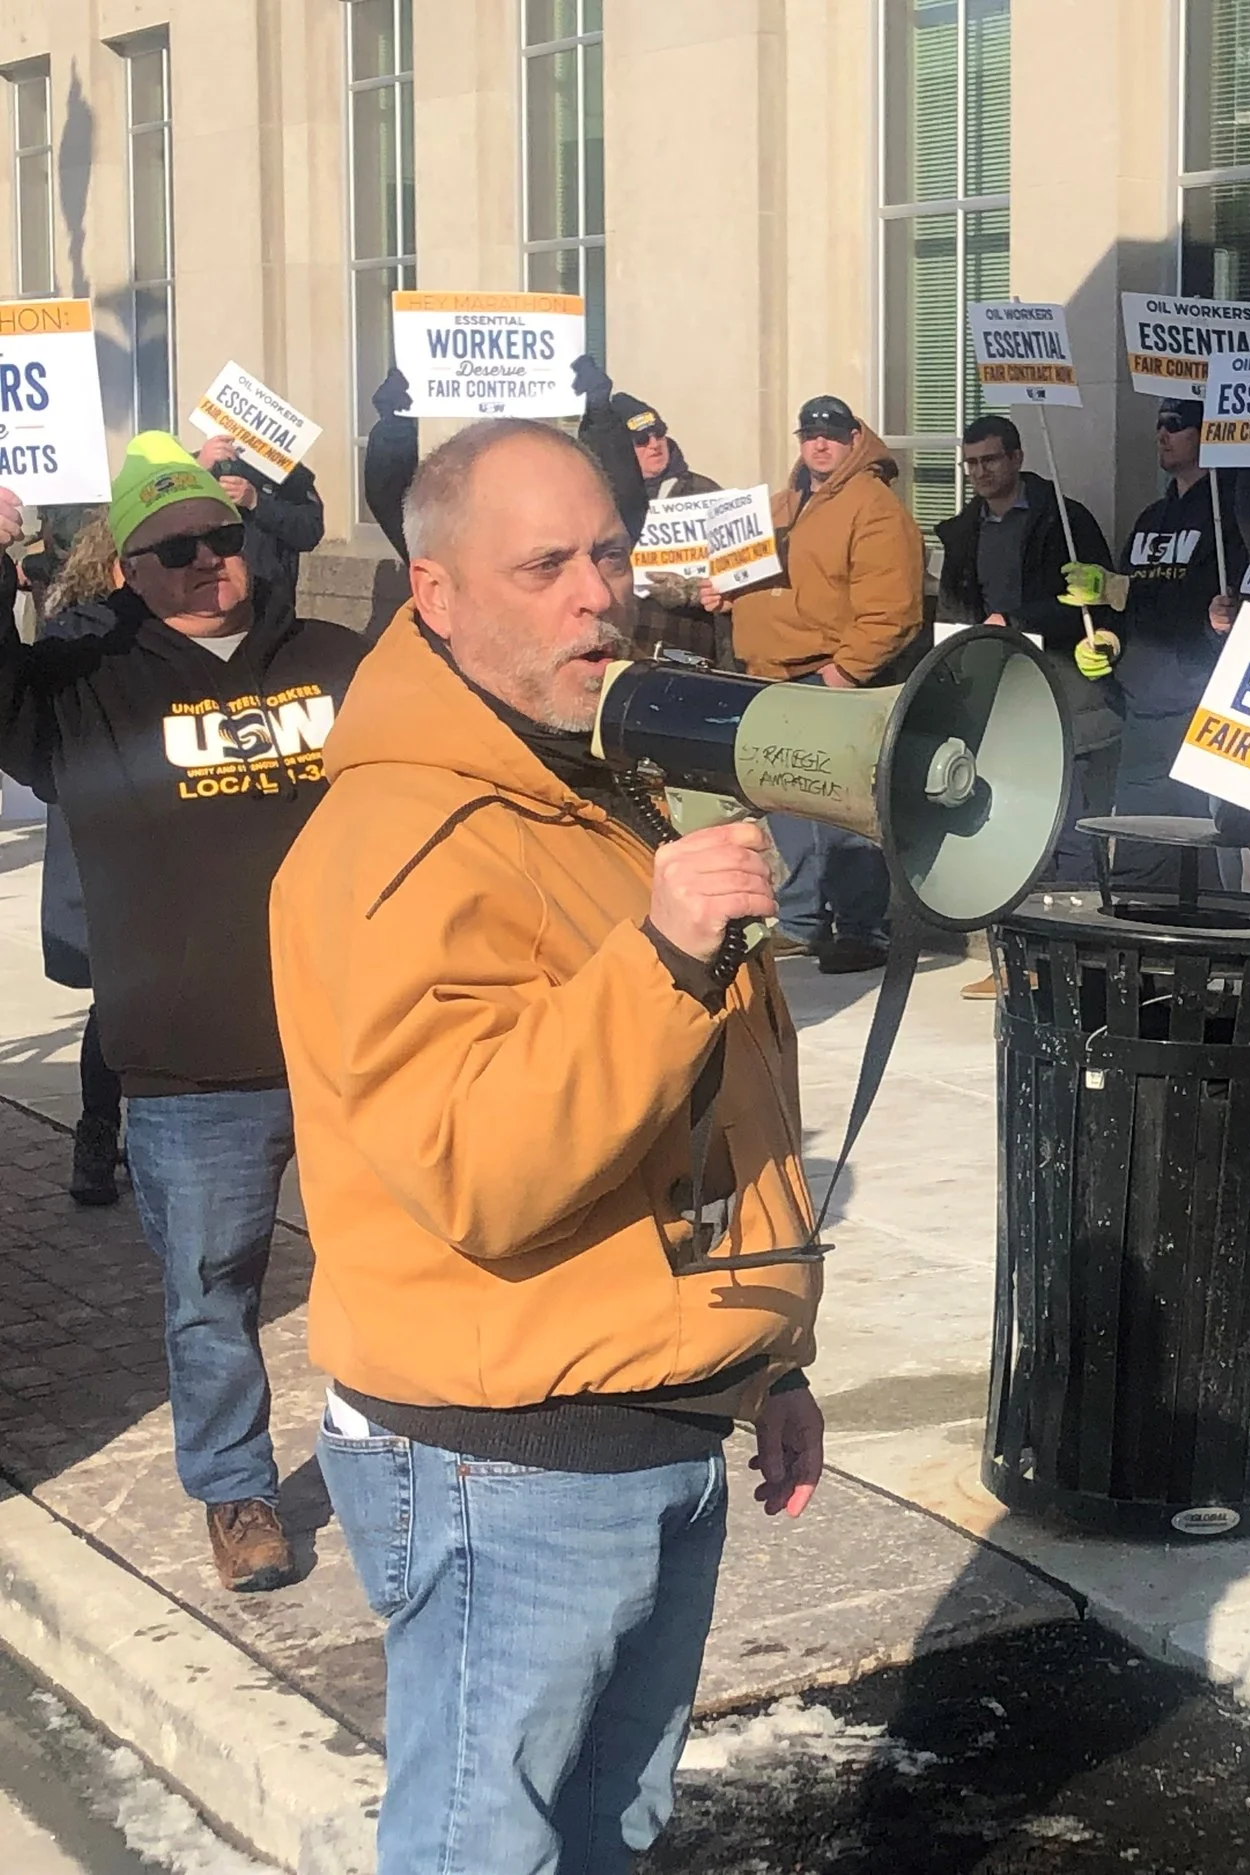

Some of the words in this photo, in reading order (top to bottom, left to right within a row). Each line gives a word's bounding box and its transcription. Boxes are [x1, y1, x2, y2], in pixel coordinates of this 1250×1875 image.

[985, 309, 1003, 320] OIL
[1004, 308, 1054, 320] WORKERS
[1146, 301, 1171, 314] OIL
[455, 316, 525, 326] ESSENTIAL
[427, 329, 555, 360] WORKERS
[982, 330, 1066, 359] ESSENTIAL
[455, 360, 527, 377] Deserve
[983, 365, 1005, 381] FAIR
[1133, 355, 1160, 373] FAIR
[428, 380, 460, 398] FAIR
[466, 380, 556, 398] CONTRACTS
[238, 376, 252, 391] OIL
[255, 388, 304, 428] WORKERS
[200, 399, 221, 418] FAIR
[220, 415, 267, 452] CONTRACT
[216, 384, 297, 453] ESSENTIAL
[1205, 421, 1236, 441] FAIR
[649, 505, 660, 515] IL
[662, 498, 722, 514] WORKE
[634, 551, 658, 565] FAIR
[739, 744, 831, 774] STRATEGIC
